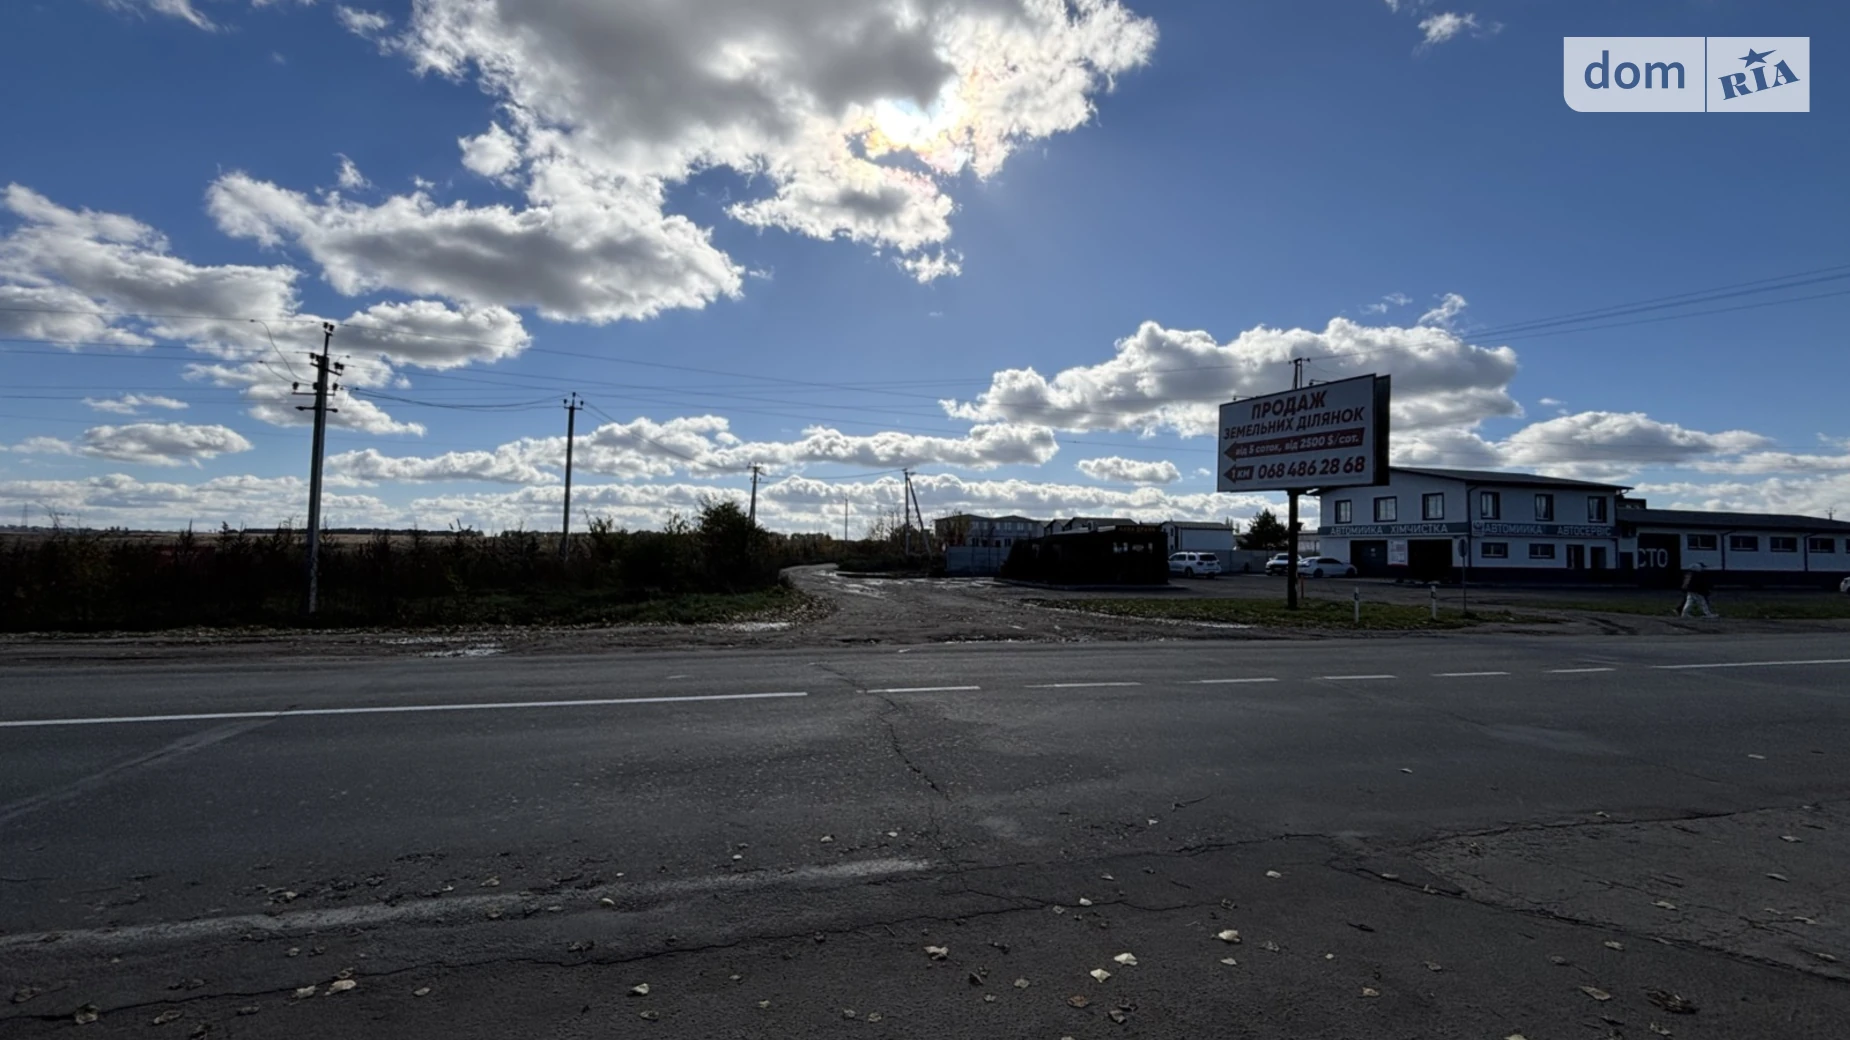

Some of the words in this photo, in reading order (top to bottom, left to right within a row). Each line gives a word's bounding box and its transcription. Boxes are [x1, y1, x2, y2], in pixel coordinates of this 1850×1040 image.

[1252, 390, 1328, 420] ПРОДАЖ
[1223, 417, 1294, 440] ЗЕМЕЛЬНИХ
[1296, 407, 1366, 430] ДІЛЯНОК
[1285, 438, 1298, 450] від
[1300, 435, 1324, 448] 2500
[1258, 462, 1285, 479] 068
[1287, 460, 1317, 478] 486
[1319, 457, 1340, 475] 28
[1343, 456, 1365, 474] 68
[1390, 523, 1449, 534] ХІМЧИСТКА
[1556, 525, 1612, 537] АВТОСЕРВІС
[1637, 547, 1669, 569] СТО
